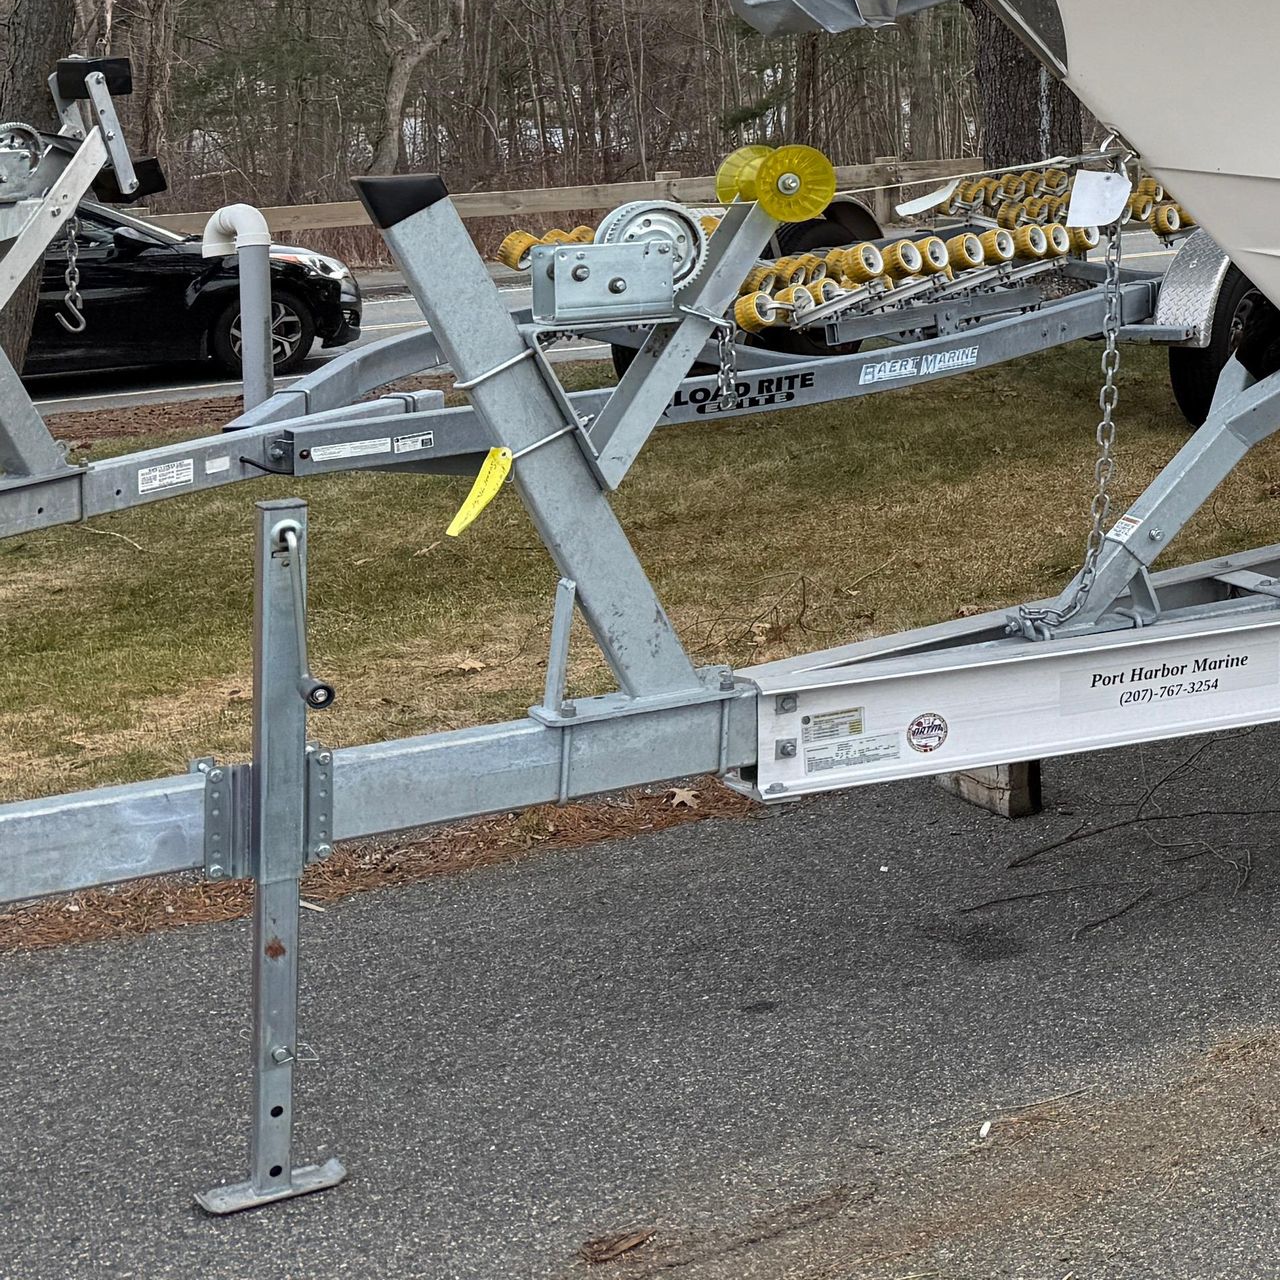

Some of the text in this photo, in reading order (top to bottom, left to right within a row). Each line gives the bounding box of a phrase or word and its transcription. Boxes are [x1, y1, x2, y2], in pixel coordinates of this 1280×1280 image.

[920, 345, 979, 376] MARINE
[758, 372, 815, 395] RITE
[1090, 654, 1249, 688] Port Harbor Marine
[1119, 678, 1220, 707] (207)-767-3254
